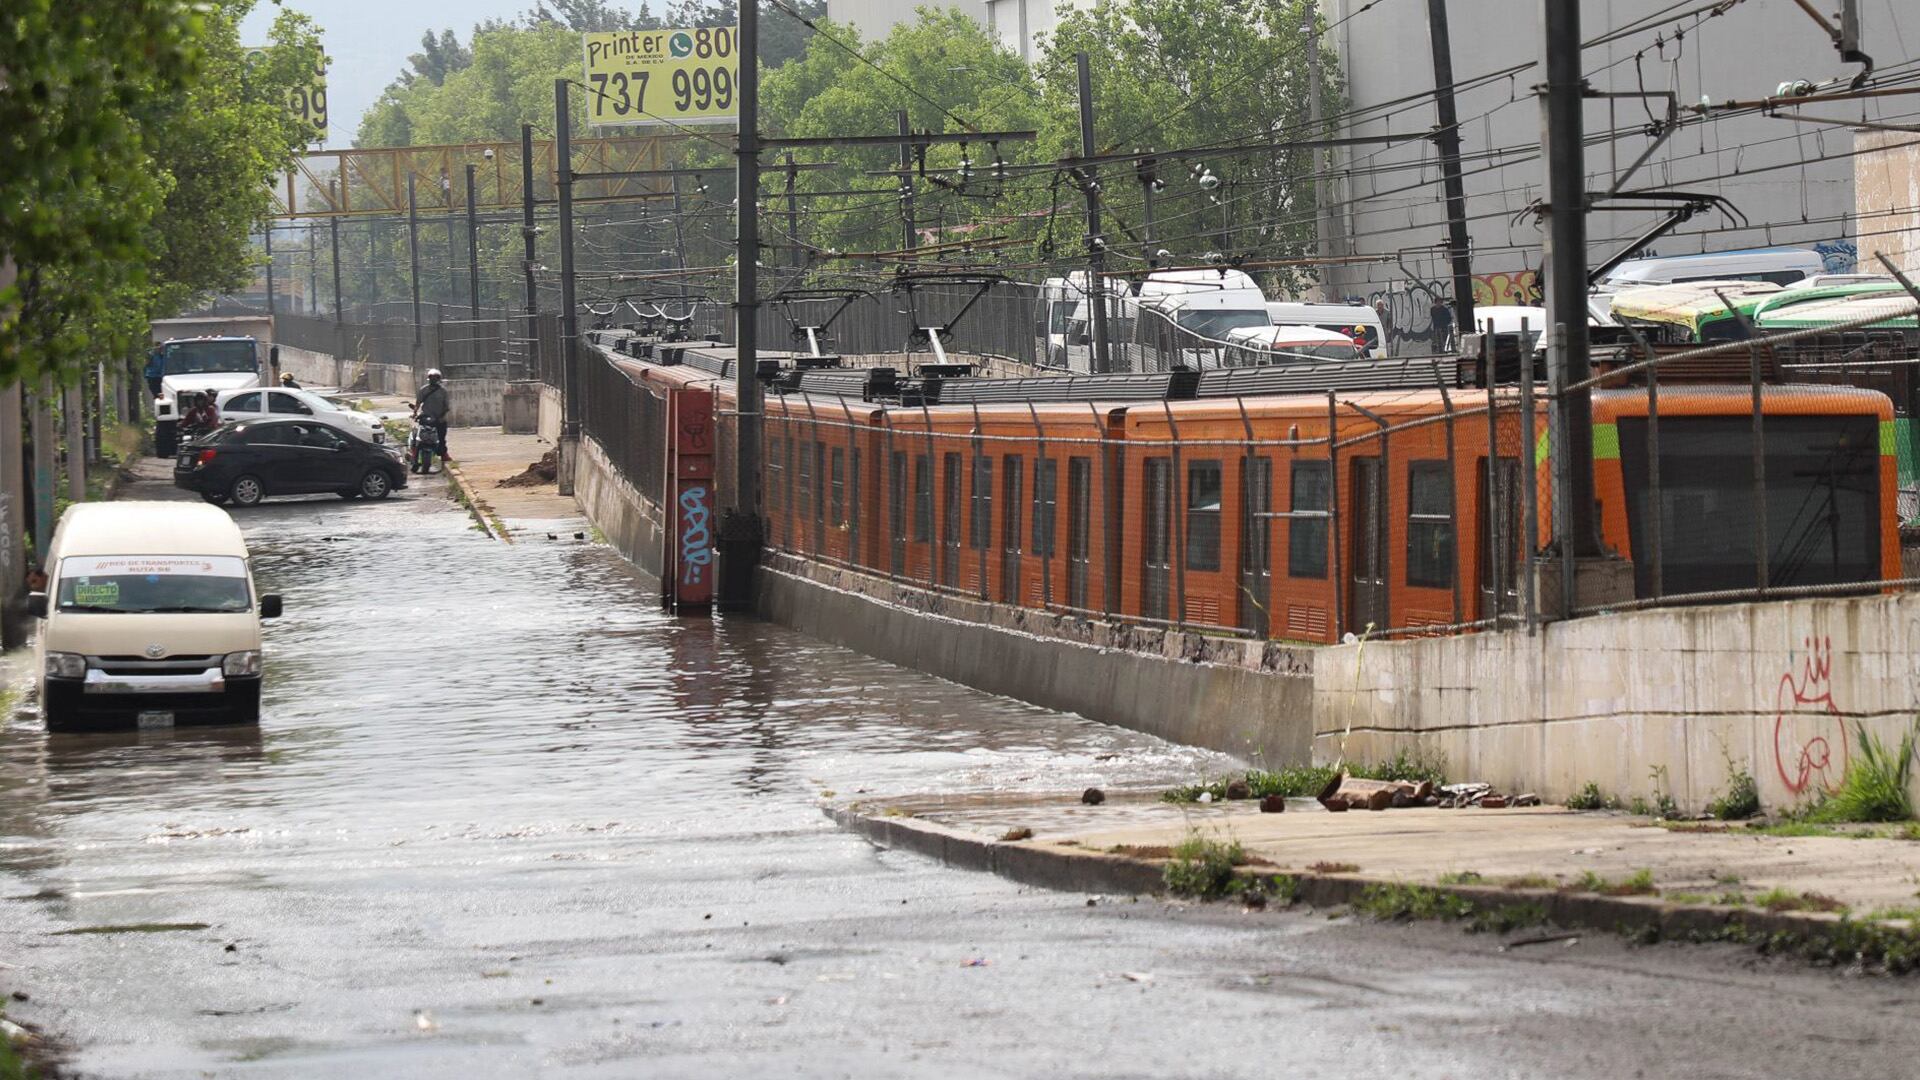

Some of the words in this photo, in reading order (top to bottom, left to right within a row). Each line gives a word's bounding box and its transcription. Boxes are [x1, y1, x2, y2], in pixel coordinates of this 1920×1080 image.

[587, 32, 663, 67] Printer
[695, 28, 738, 59] 80
[590, 72, 649, 116] 737
[672, 66, 738, 111] 999
